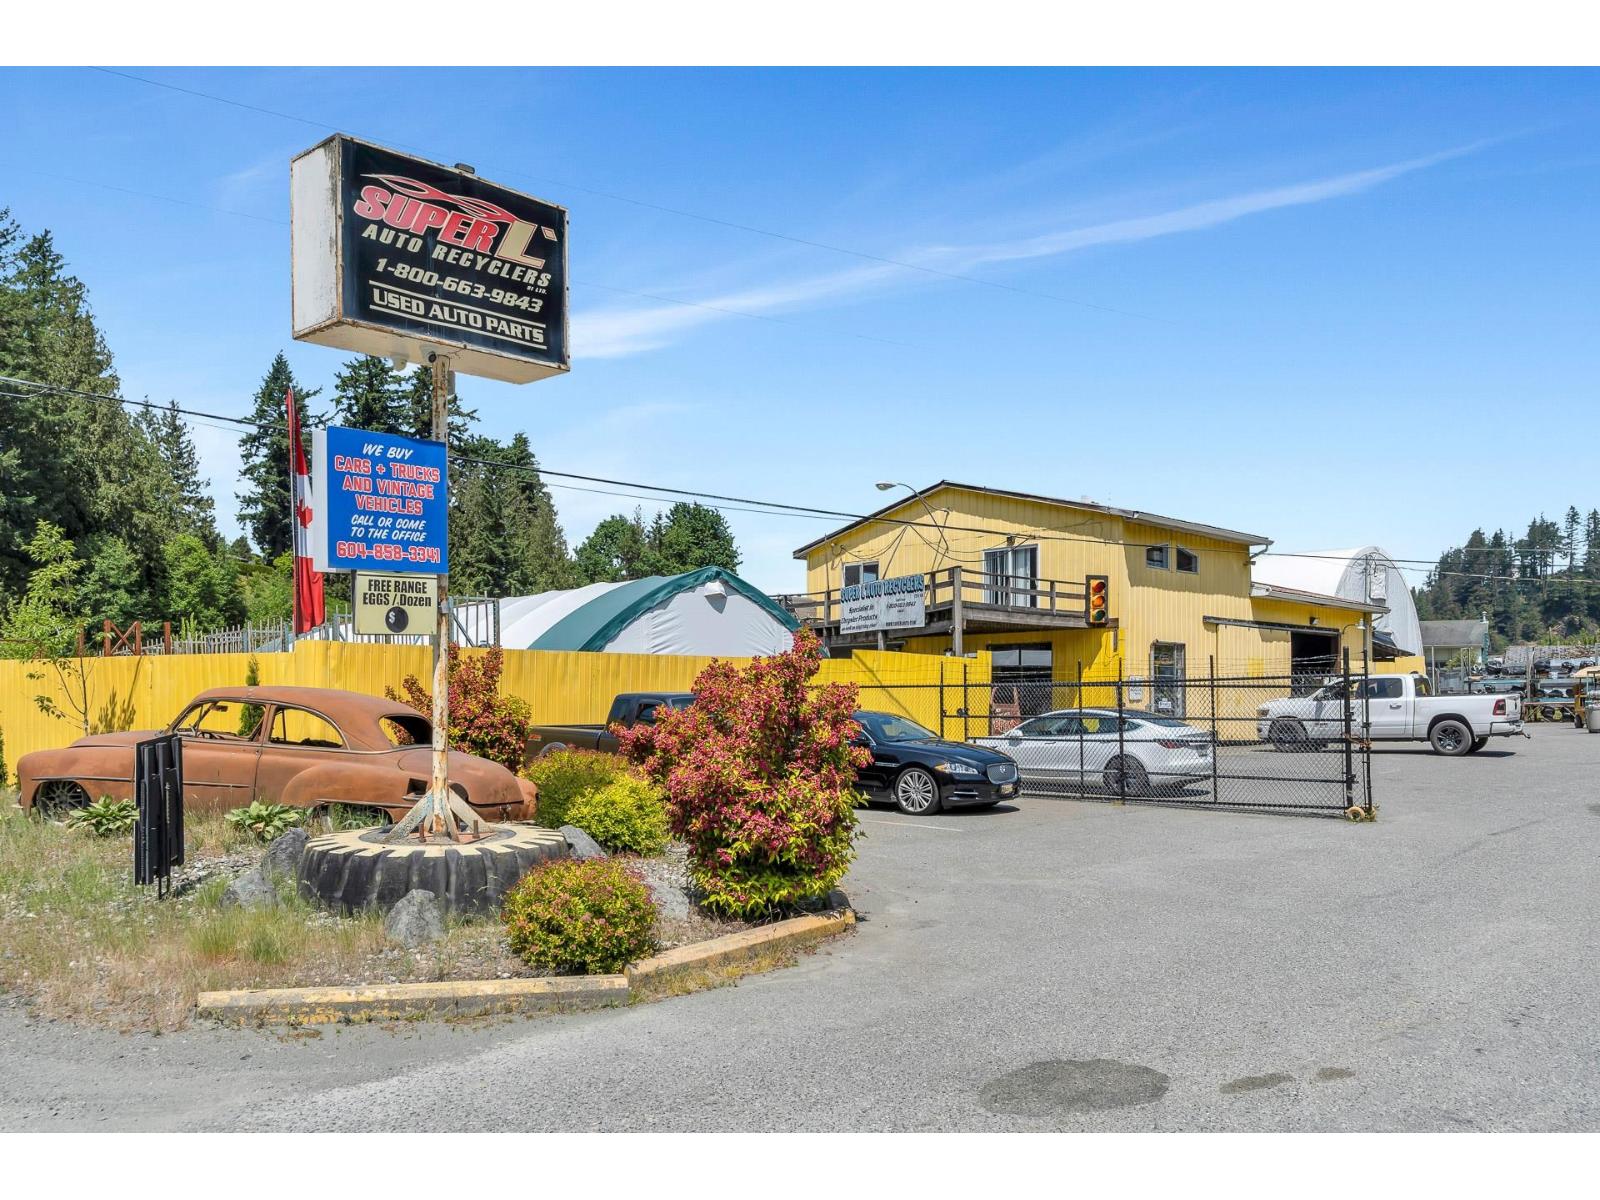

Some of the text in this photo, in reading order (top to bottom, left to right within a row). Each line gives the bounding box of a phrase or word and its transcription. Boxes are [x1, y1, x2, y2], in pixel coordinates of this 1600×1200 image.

[353, 185, 546, 270] SUPER L
[361, 224, 552, 287] AUTO RECYCLERS
[376, 258, 544, 313] 1-800-663-9843
[373, 288, 544, 344] USED AUTO PARTS
[362, 443, 414, 460] WE BUY
[334, 455, 440, 483] CARS + TRUCKS
[343, 475, 434, 499] AND VINTAGE
[355, 494, 423, 515] VEHICLES
[351, 514, 426, 530] CALL OR COME
[351, 526, 428, 542] TO THE OFFICE
[336, 541, 440, 564] 604-858-3341
[368, 579, 428, 594] FREE RANGE
[841, 584, 860, 603] SUPER
[865, 581, 882, 599] AUTO
[884, 574, 924, 596] RECYCLERS
[362, 593, 390, 606] EGGS
[400, 594, 432, 607] Dozen
